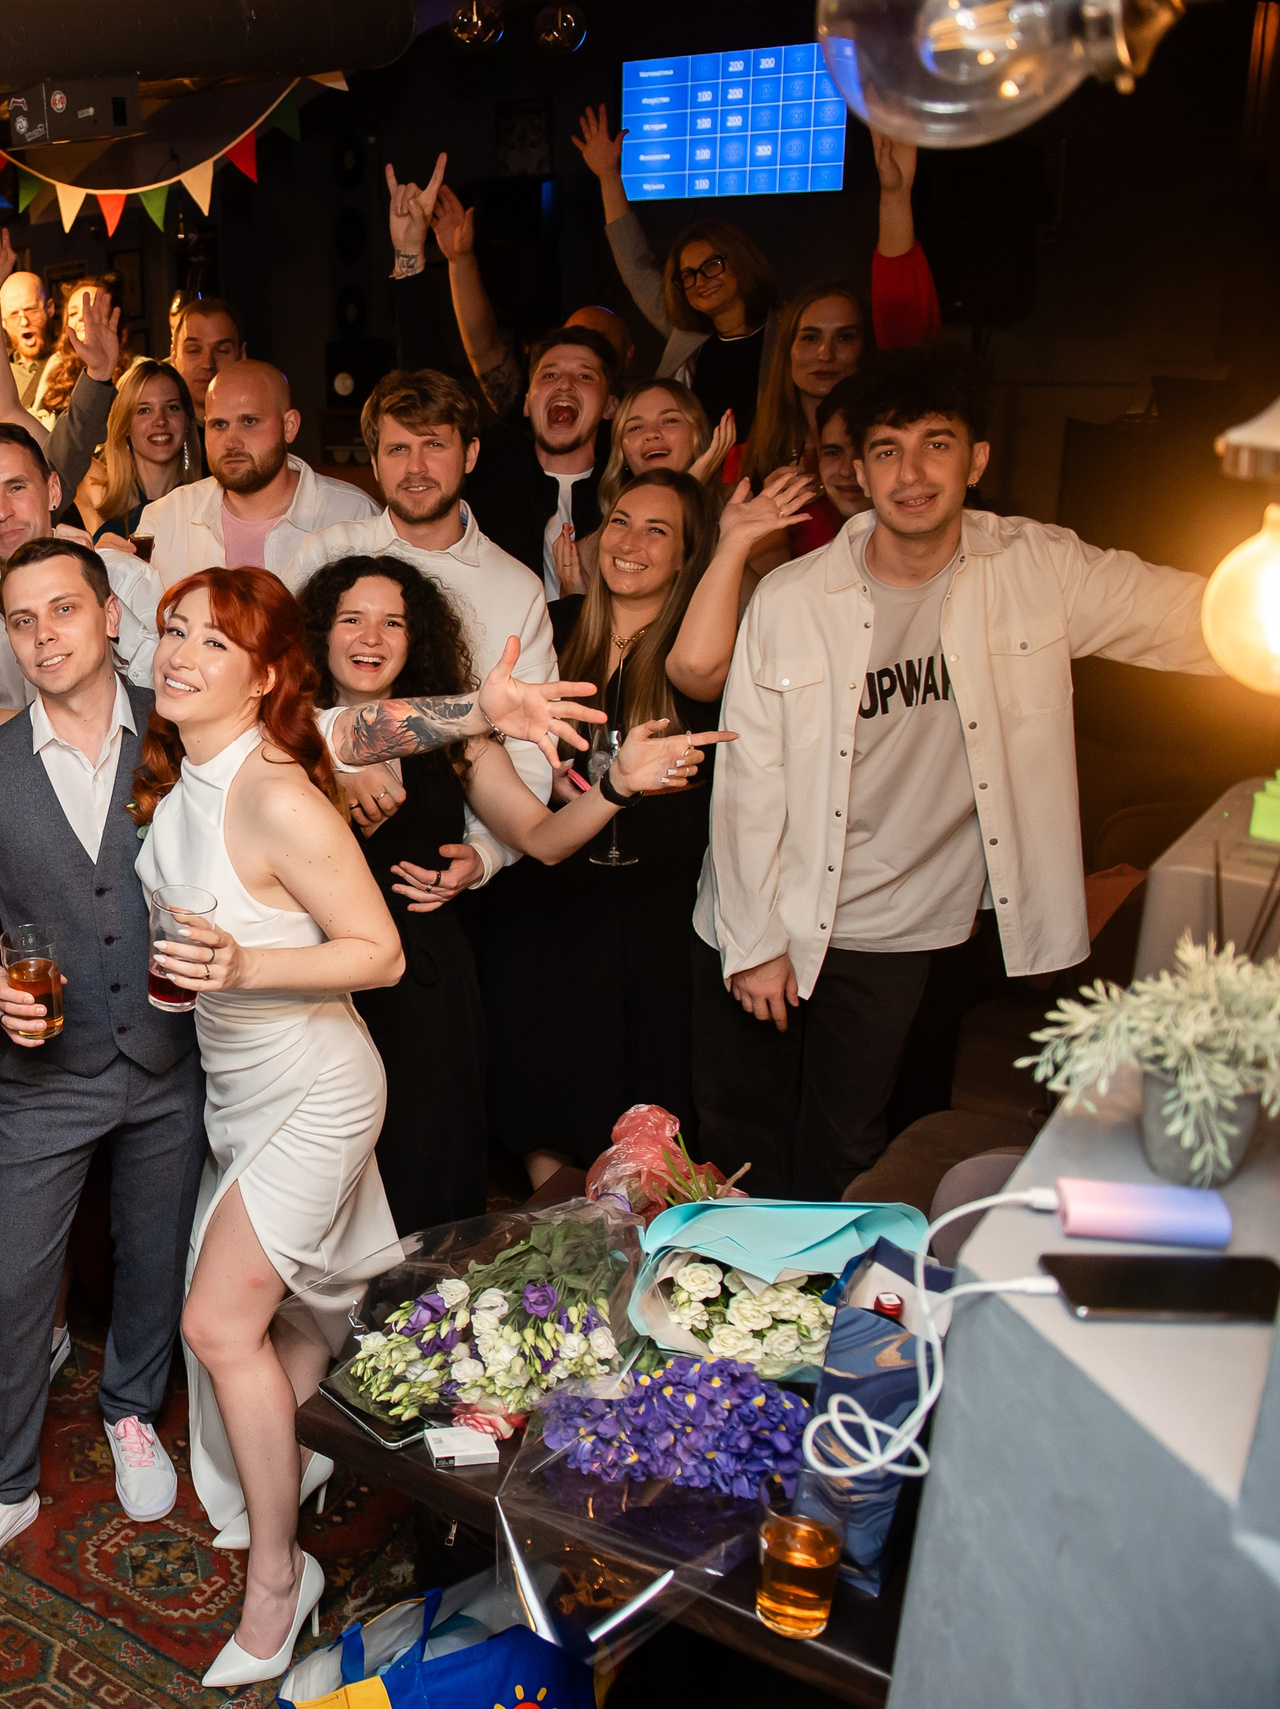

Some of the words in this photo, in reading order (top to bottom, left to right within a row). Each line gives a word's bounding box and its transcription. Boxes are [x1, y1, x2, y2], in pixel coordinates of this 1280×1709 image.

[729, 61, 744, 71] 200
[760, 58, 775, 69] 300
[697, 91, 712, 102] 100
[727, 88, 743, 99] 200
[696, 118, 712, 129] 100
[726, 116, 742, 127] 200
[695, 149, 711, 160] 100
[756, 145, 772, 156] 300
[695, 179, 710, 190] 100
